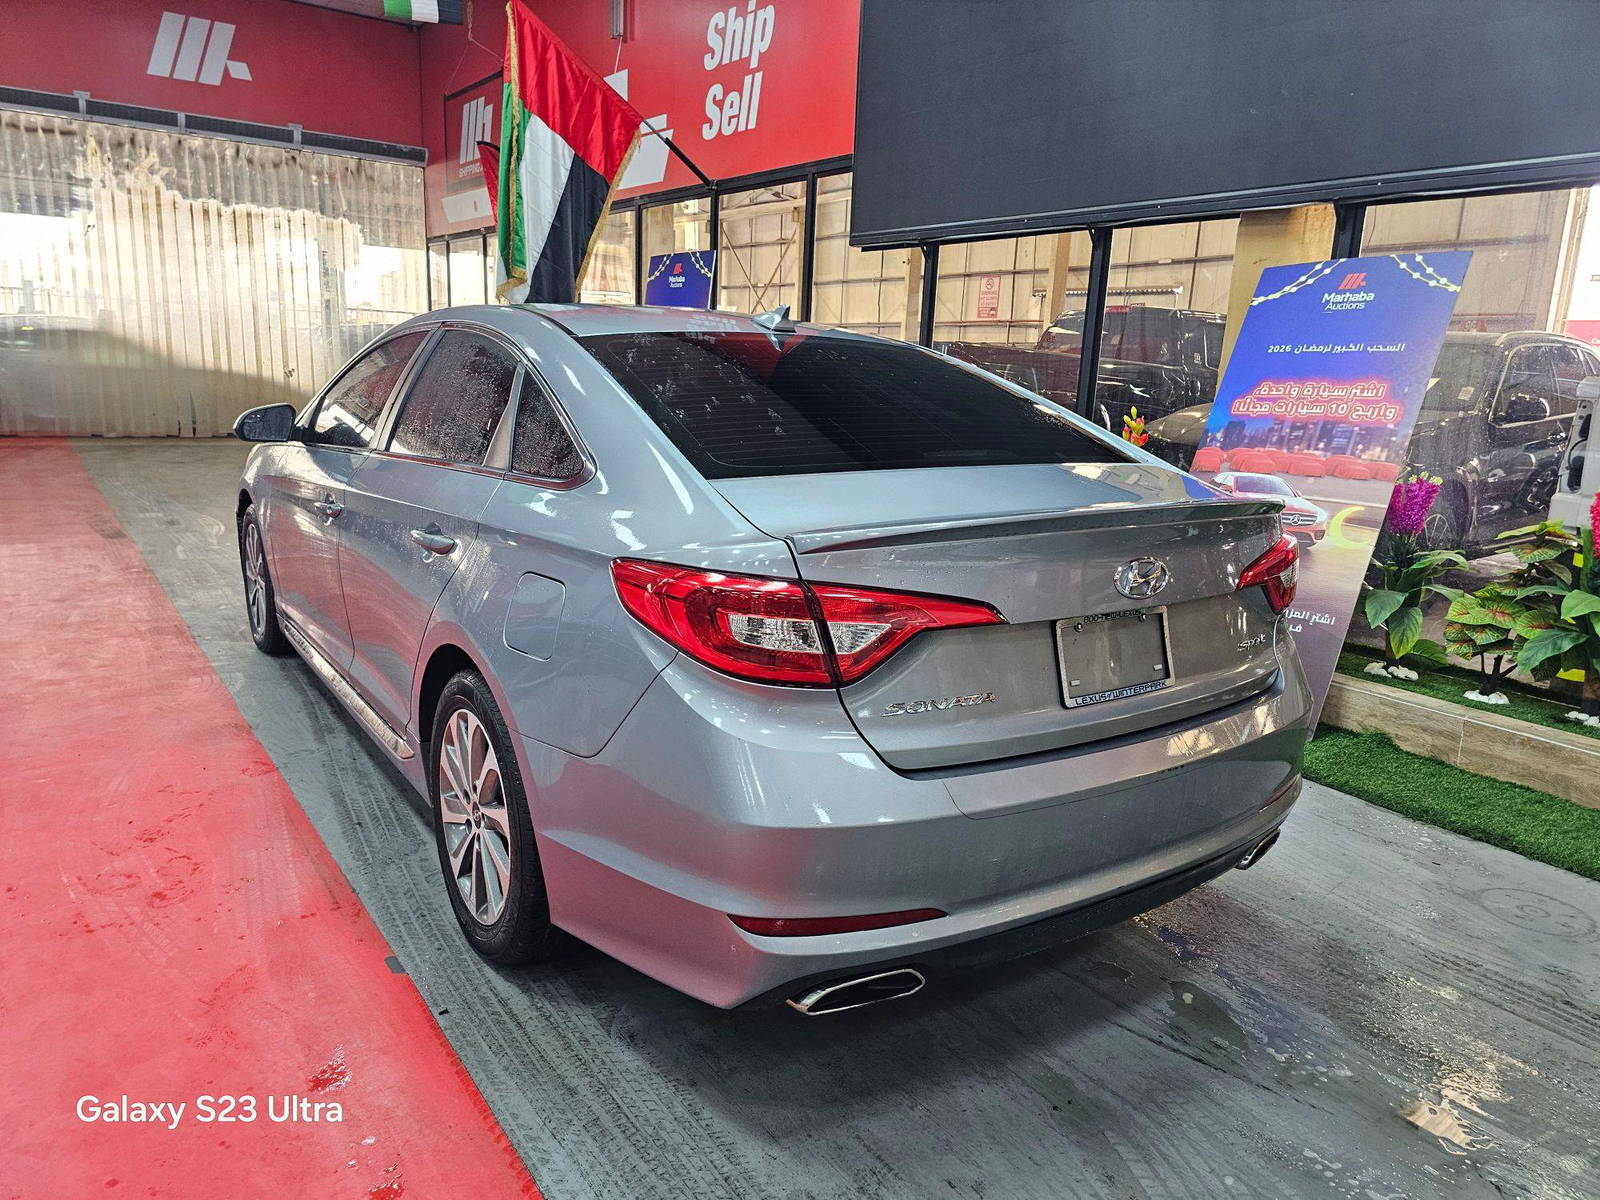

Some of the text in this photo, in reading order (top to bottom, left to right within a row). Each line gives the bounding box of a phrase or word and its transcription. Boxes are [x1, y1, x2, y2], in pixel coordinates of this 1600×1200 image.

[704, 0, 775, 70] Ship
[702, 71, 763, 140] Sell
[1321, 291, 1375, 303] Marhaba
[1324, 301, 1366, 311] Auctions
[1267, 343, 1406, 354] السحب الكبير لرمضان 2026
[1303, 383, 1346, 399] سيارة
[1275, 401, 1325, 416] سيارات
[1329, 402, 1348, 415] 10
[1352, 404, 1397, 420] واربح
[880, 692, 997, 717] SONATA
[1075, 693, 1106, 706] LEXUS
